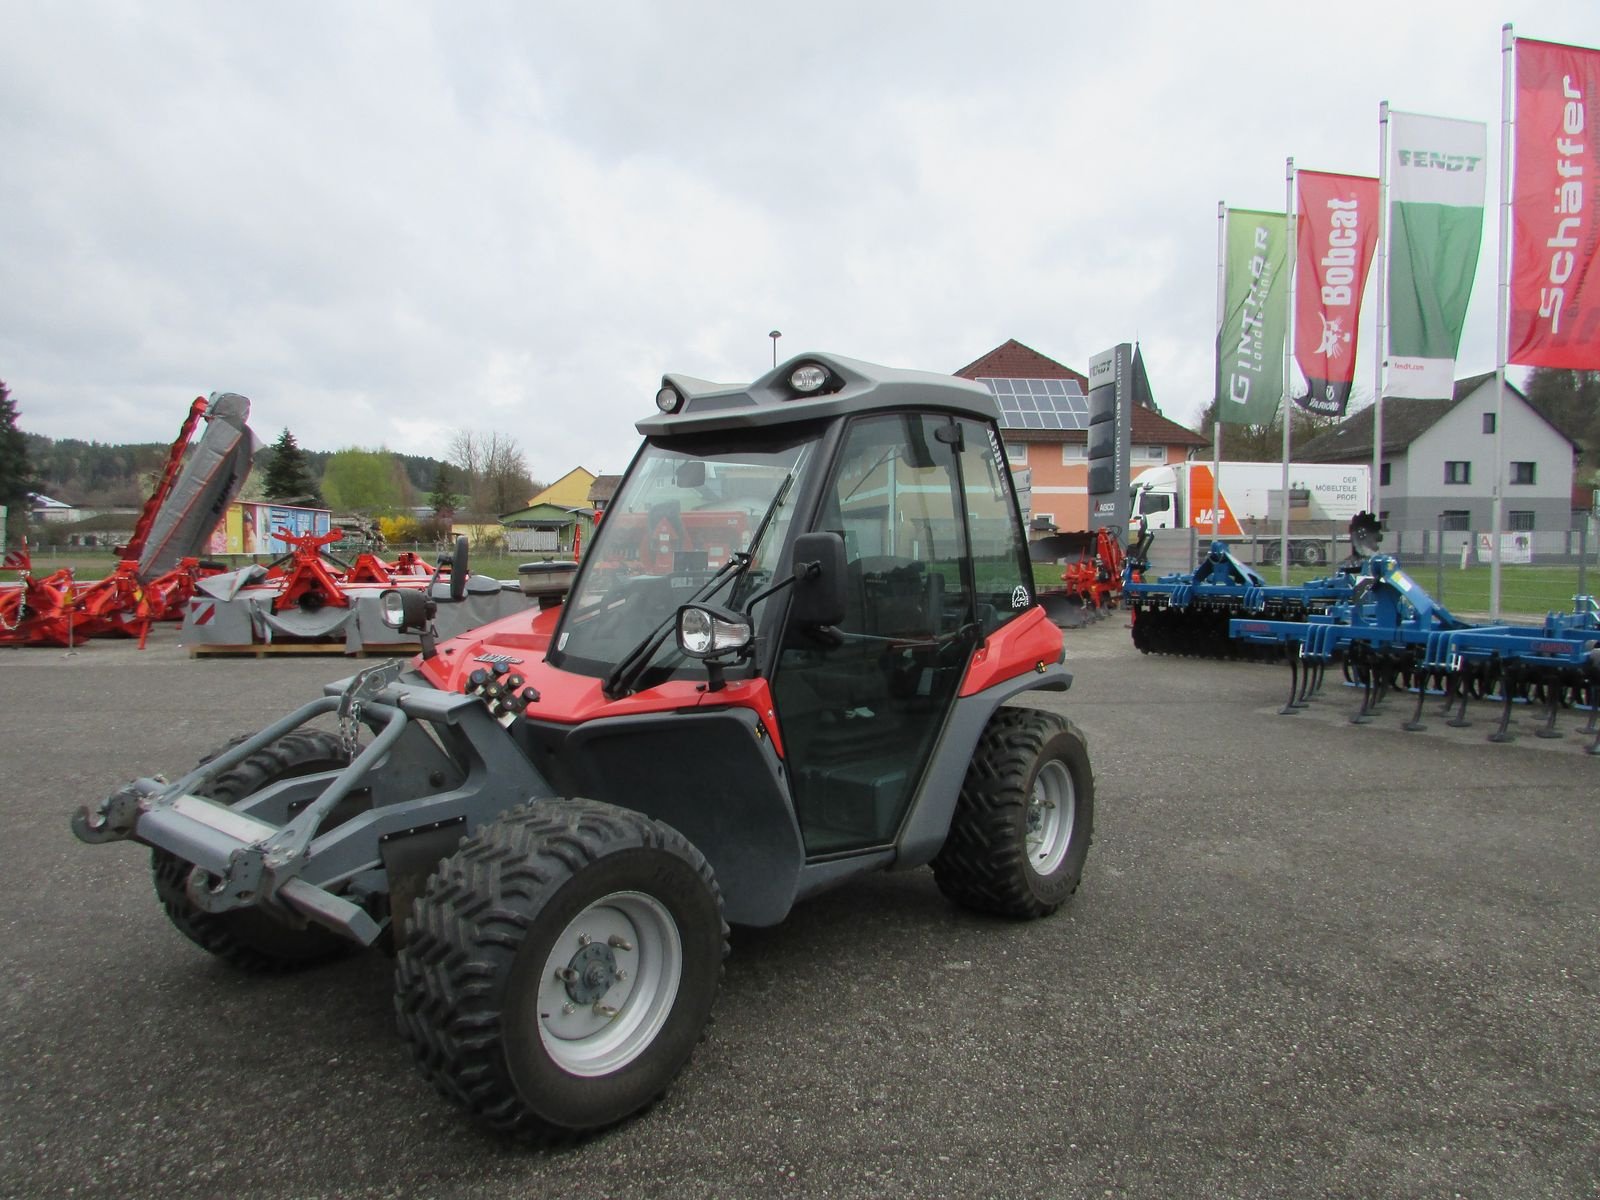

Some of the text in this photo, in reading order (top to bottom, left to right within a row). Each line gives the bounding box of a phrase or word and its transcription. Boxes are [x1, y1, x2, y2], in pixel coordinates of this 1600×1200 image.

[1398, 149, 1482, 172] FENDT
[1538, 75, 1584, 334] Schäffer
[1320, 198, 1358, 305] Bobcat
[1395, 362, 1425, 371] fendt.com
[987, 430, 1003, 470] AEBI
[1342, 476, 1357, 484] DER
[1315, 484, 1358, 492] MÖBELTEILE
[1336, 493, 1357, 501] PROFI
[1099, 503, 1115, 511] AGCO
